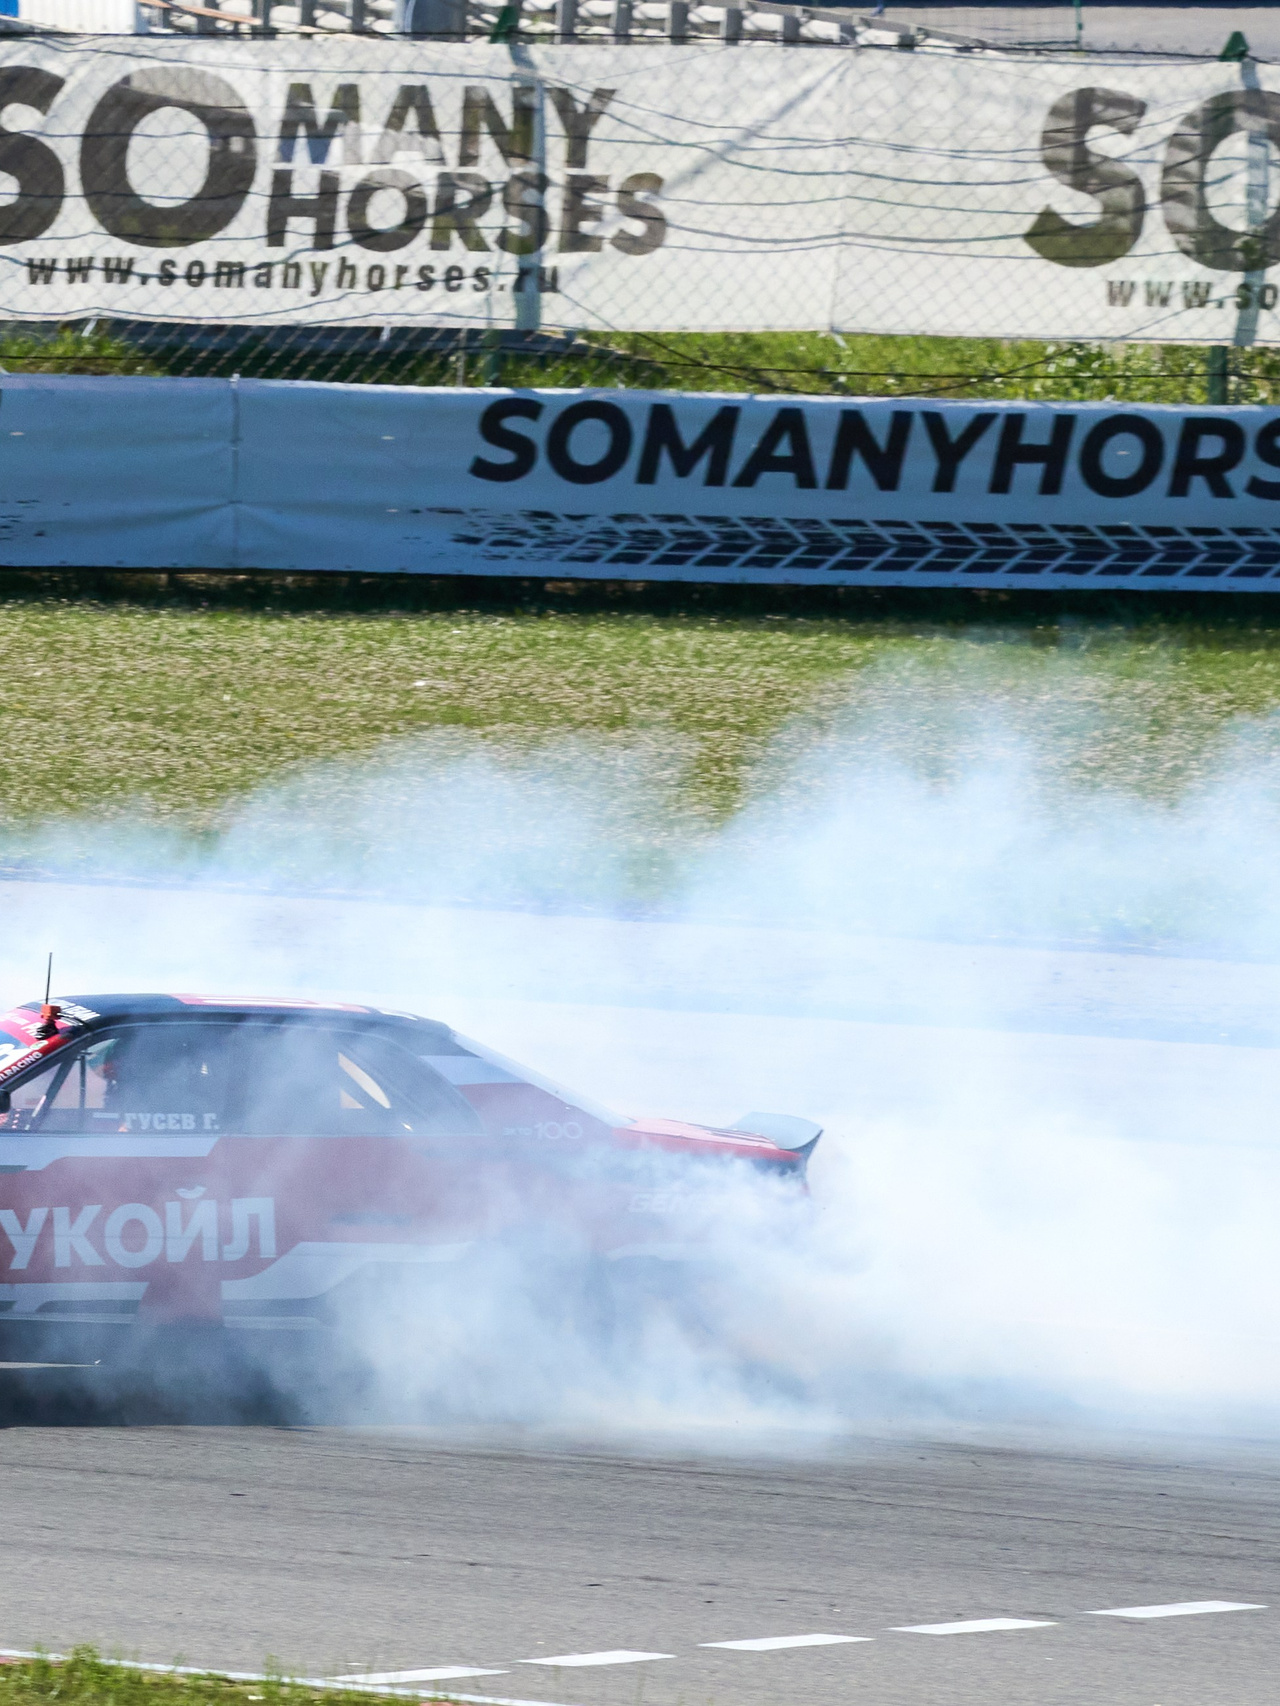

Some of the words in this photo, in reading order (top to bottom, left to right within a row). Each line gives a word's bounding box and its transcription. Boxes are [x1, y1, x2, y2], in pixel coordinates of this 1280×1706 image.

[278, 83, 616, 168] MANY
[1023, 87, 1280, 272] SO
[267, 168, 667, 256] HORSES
[26, 256, 560, 297] www.somanyhorses.ru
[124, 1113, 195, 1130] ГУСЕВ
[533, 1121, 584, 1140] 100
